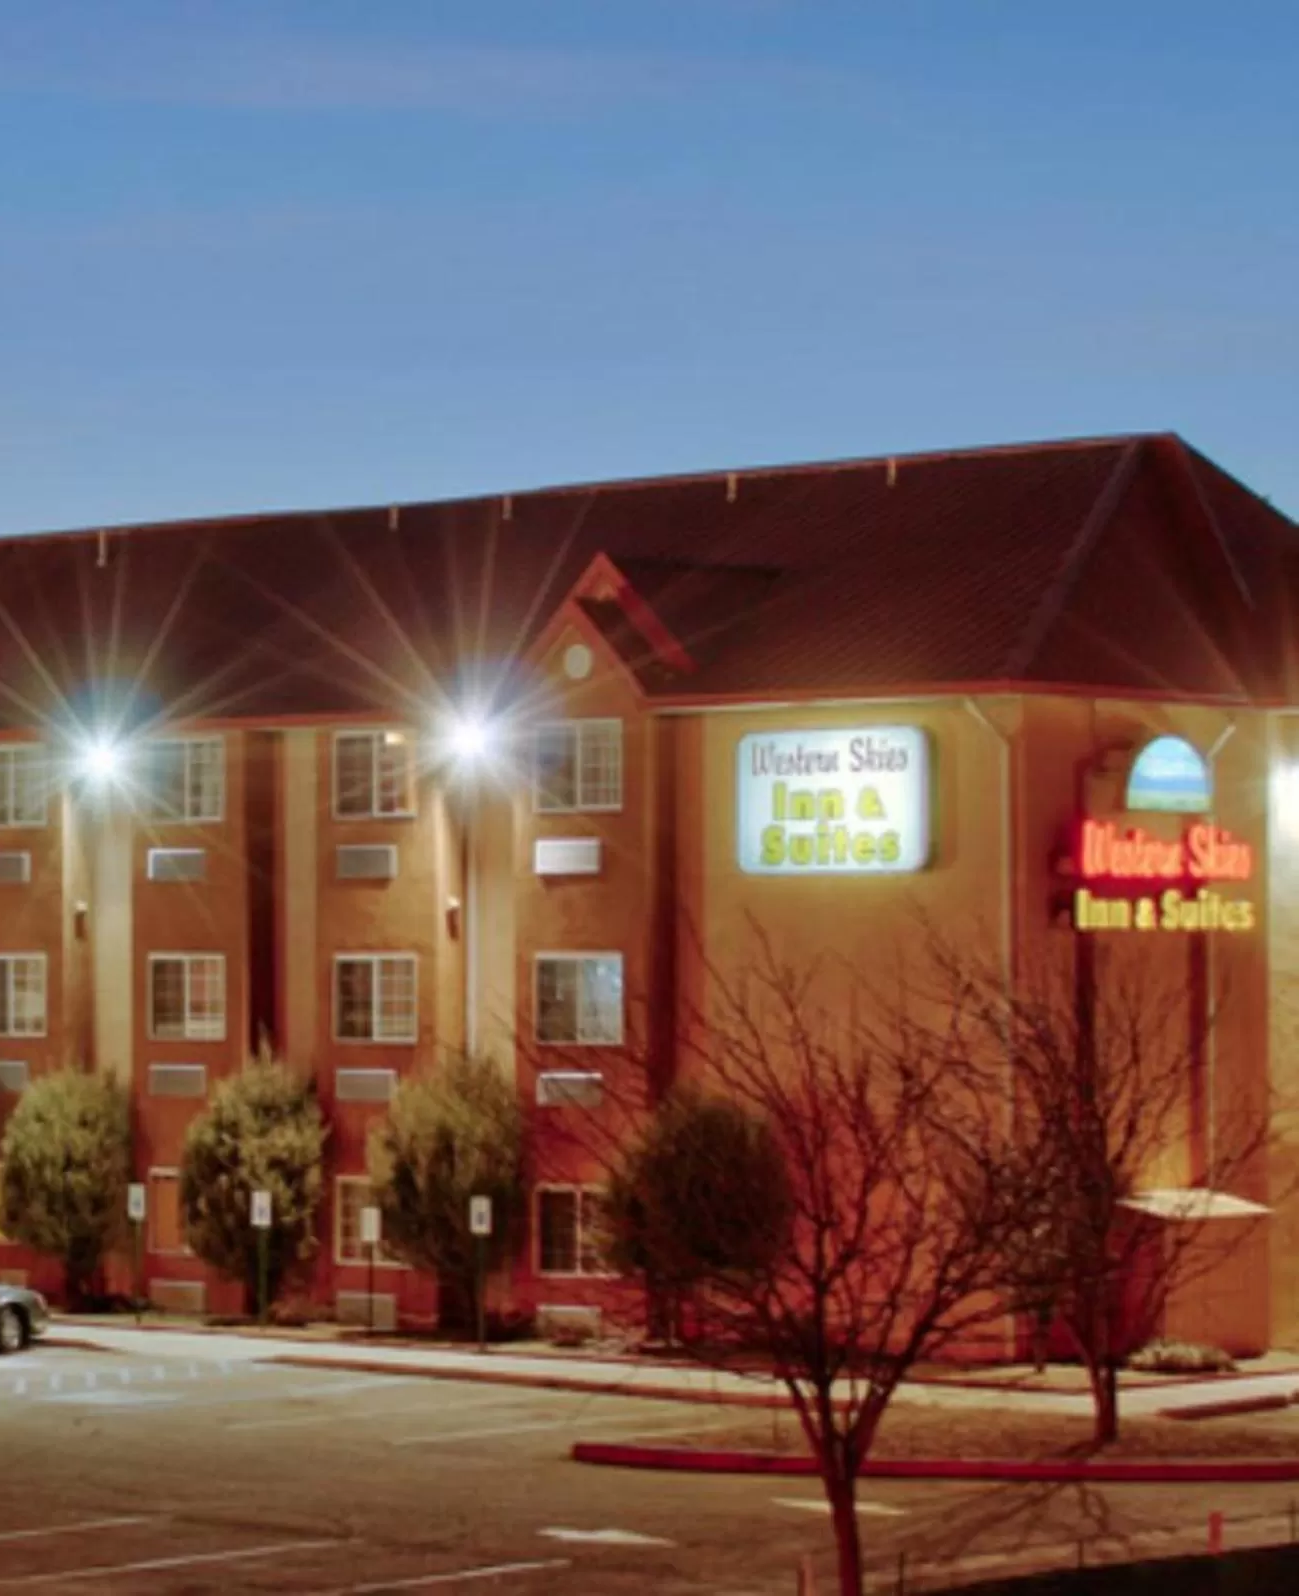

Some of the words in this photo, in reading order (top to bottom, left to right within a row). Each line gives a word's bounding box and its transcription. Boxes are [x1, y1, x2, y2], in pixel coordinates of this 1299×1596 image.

[773, 780, 844, 820] Inn
[856, 785, 888, 820] &
[760, 821, 901, 865] Suites
[1075, 888, 1130, 930] Inn
[1136, 897, 1157, 930] &
[1160, 888, 1254, 930] Suites
